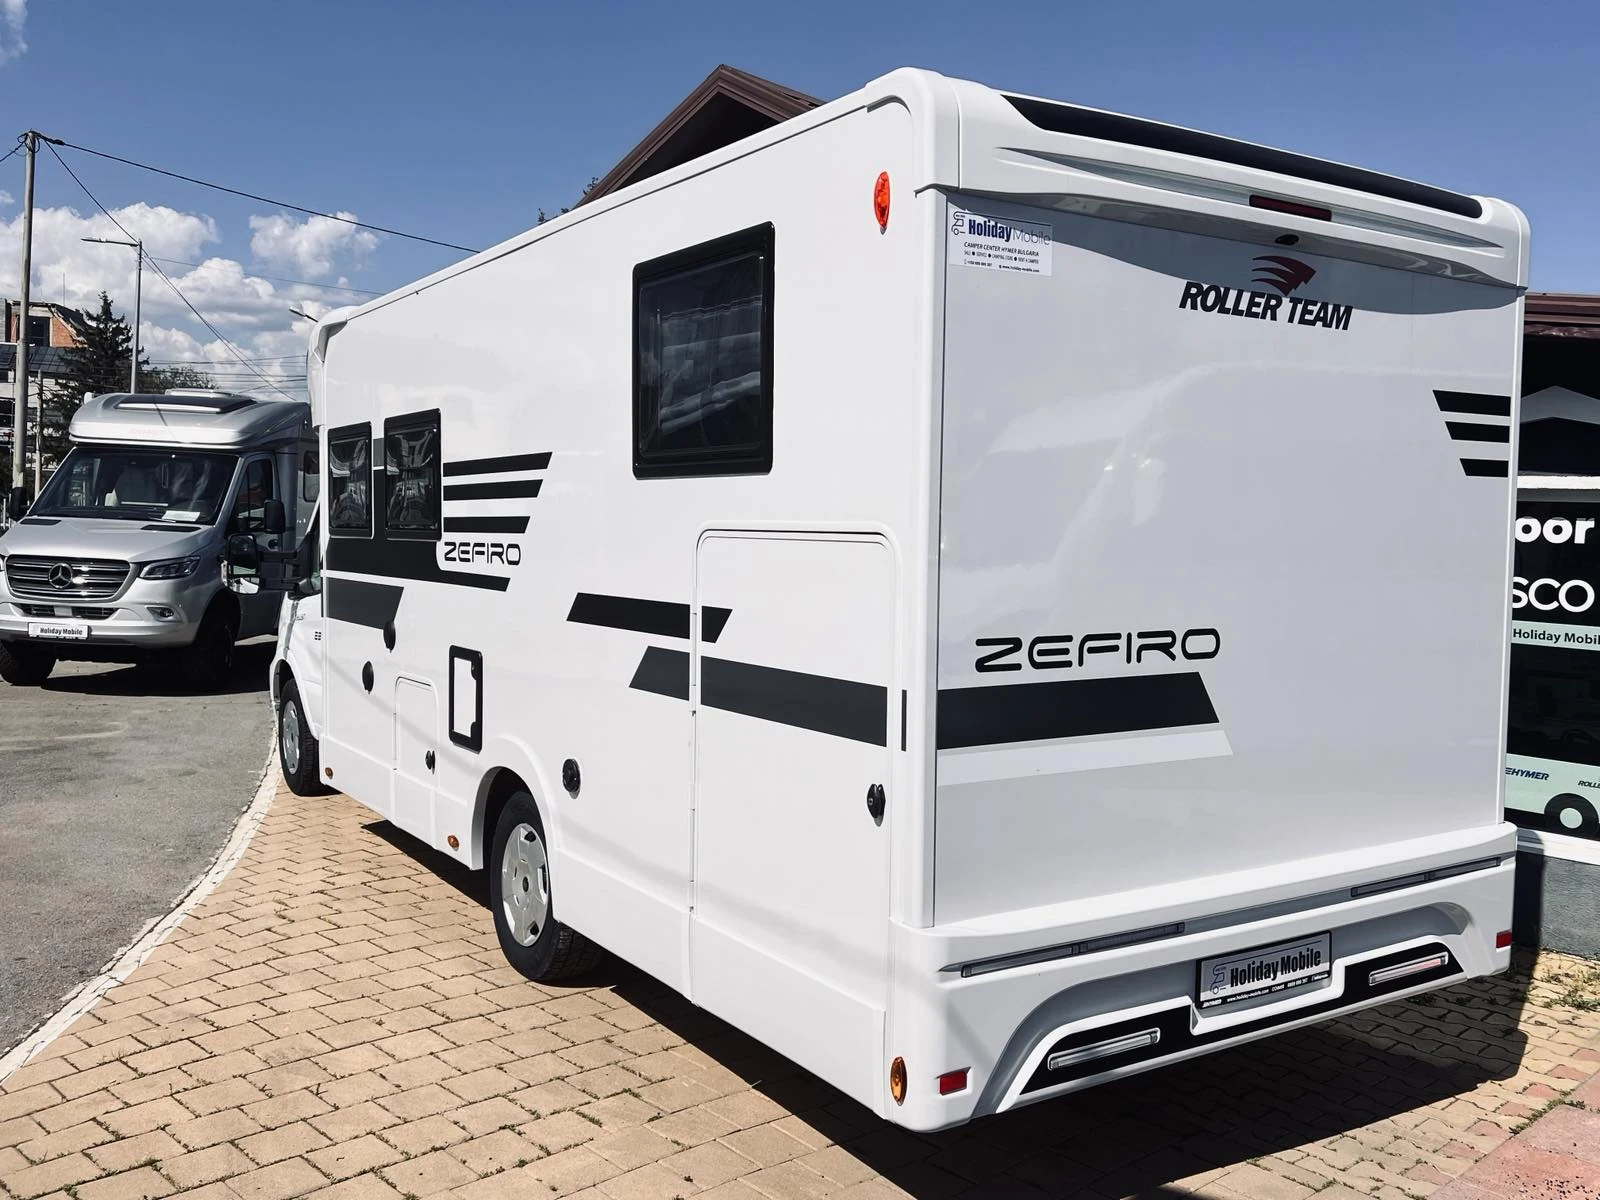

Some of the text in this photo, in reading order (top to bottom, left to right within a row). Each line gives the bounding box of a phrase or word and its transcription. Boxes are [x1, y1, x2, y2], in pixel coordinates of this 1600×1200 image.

[968, 219, 1012, 242] Holiday
[964, 242, 983, 250] CAMPER
[984, 244, 1001, 252] CENTER
[1001, 246, 1017, 254] HYMER
[1178, 281, 1353, 331] ROLLER TEAM
[444, 541, 521, 566] ZEFIRO
[40, 627, 83, 636] Holiday Mobile
[1513, 628, 1561, 644] Holiday
[975, 628, 1221, 673] ZEFIRO
[1230, 947, 1322, 988] Holiday Mobile
